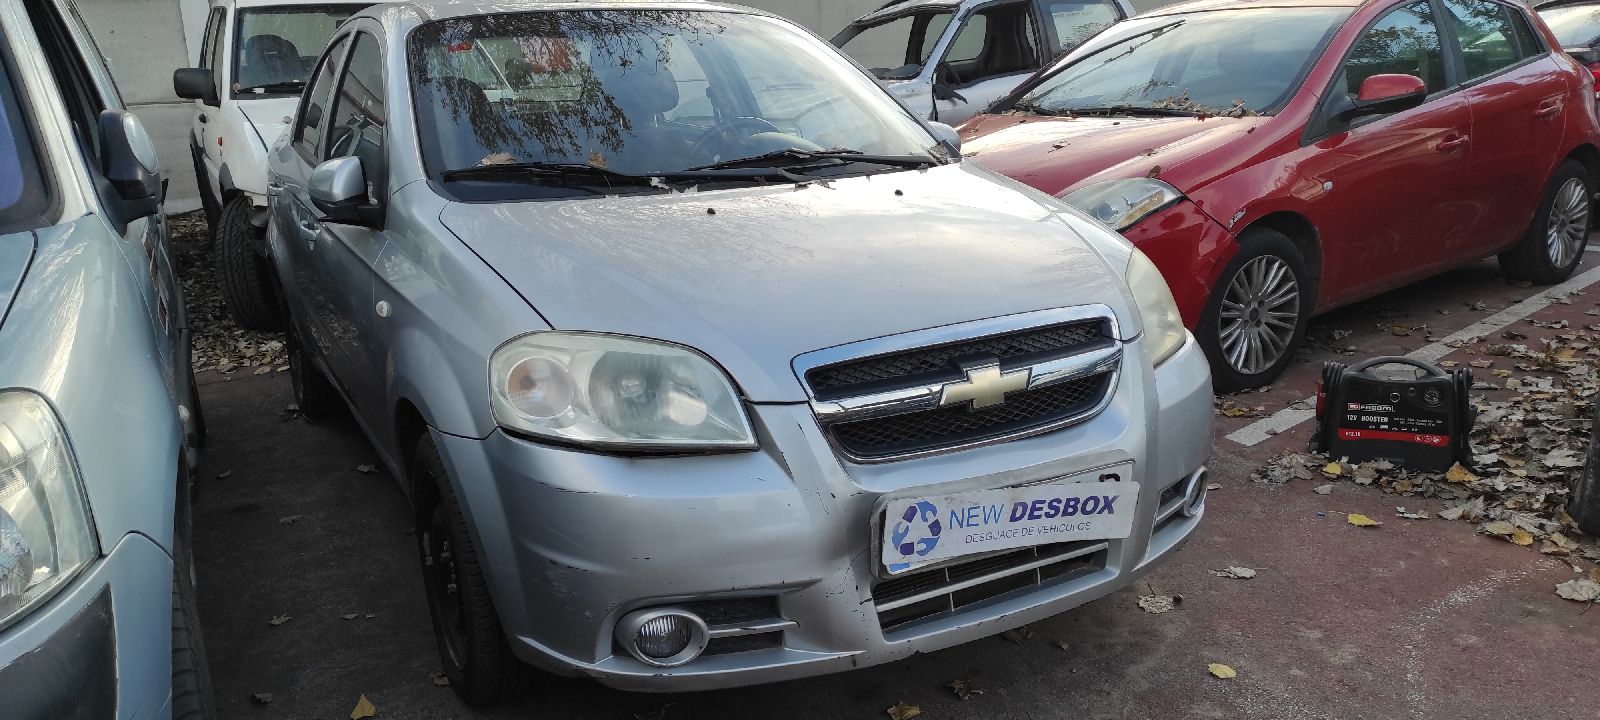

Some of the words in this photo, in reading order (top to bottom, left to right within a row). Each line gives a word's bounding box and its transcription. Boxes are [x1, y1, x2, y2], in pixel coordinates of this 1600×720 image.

[1361, 415, 1389, 423] BOOSTER
[949, 503, 1005, 530] NEW
[1009, 494, 1120, 523] DESBOX
[965, 528, 1019, 544] DESGUACE
[1021, 526, 1035, 537] DE
